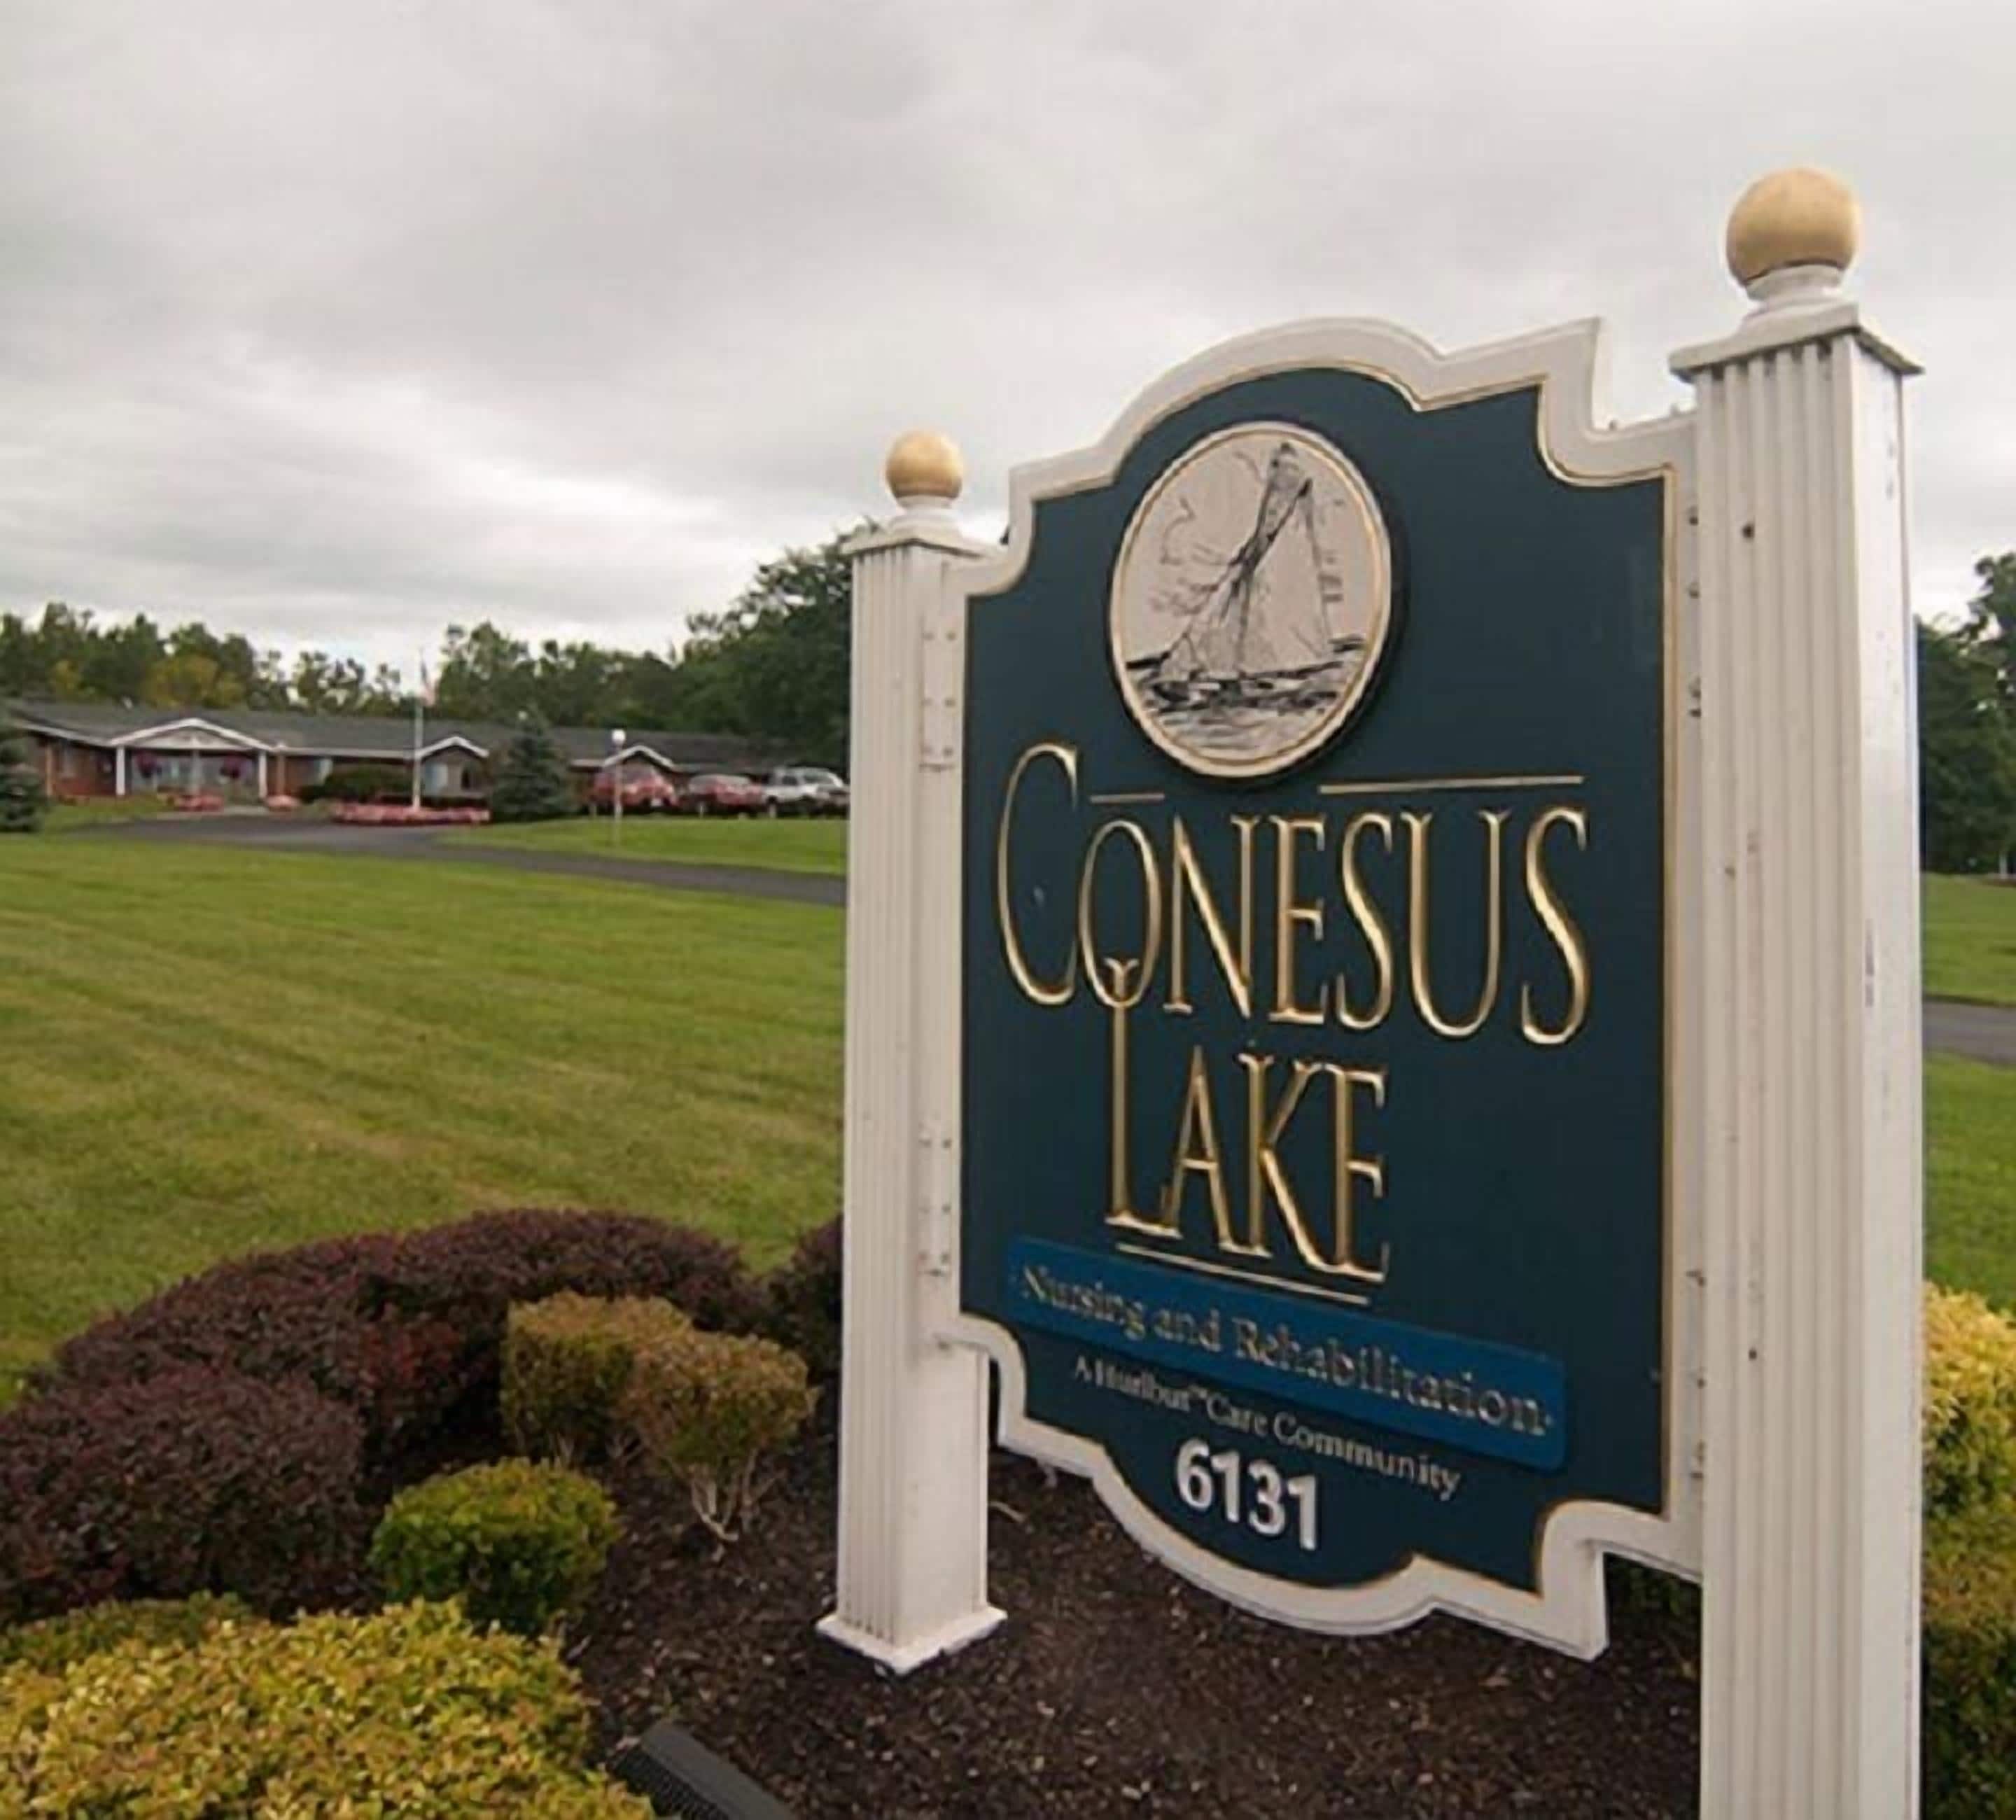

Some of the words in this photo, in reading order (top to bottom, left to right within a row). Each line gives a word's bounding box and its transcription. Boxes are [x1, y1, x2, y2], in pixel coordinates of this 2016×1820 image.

[997, 742, 1591, 1044] CONESUS
[1105, 957, 1390, 1282] LAKE
[1021, 1265, 1146, 1340] Nursing
[1153, 1308, 1223, 1352] and
[1074, 1355, 1093, 1382] A
[1206, 1394, 1268, 1437] Care
[1273, 1411, 1461, 1502] Community
[1176, 1438, 1316, 1552] 6131
